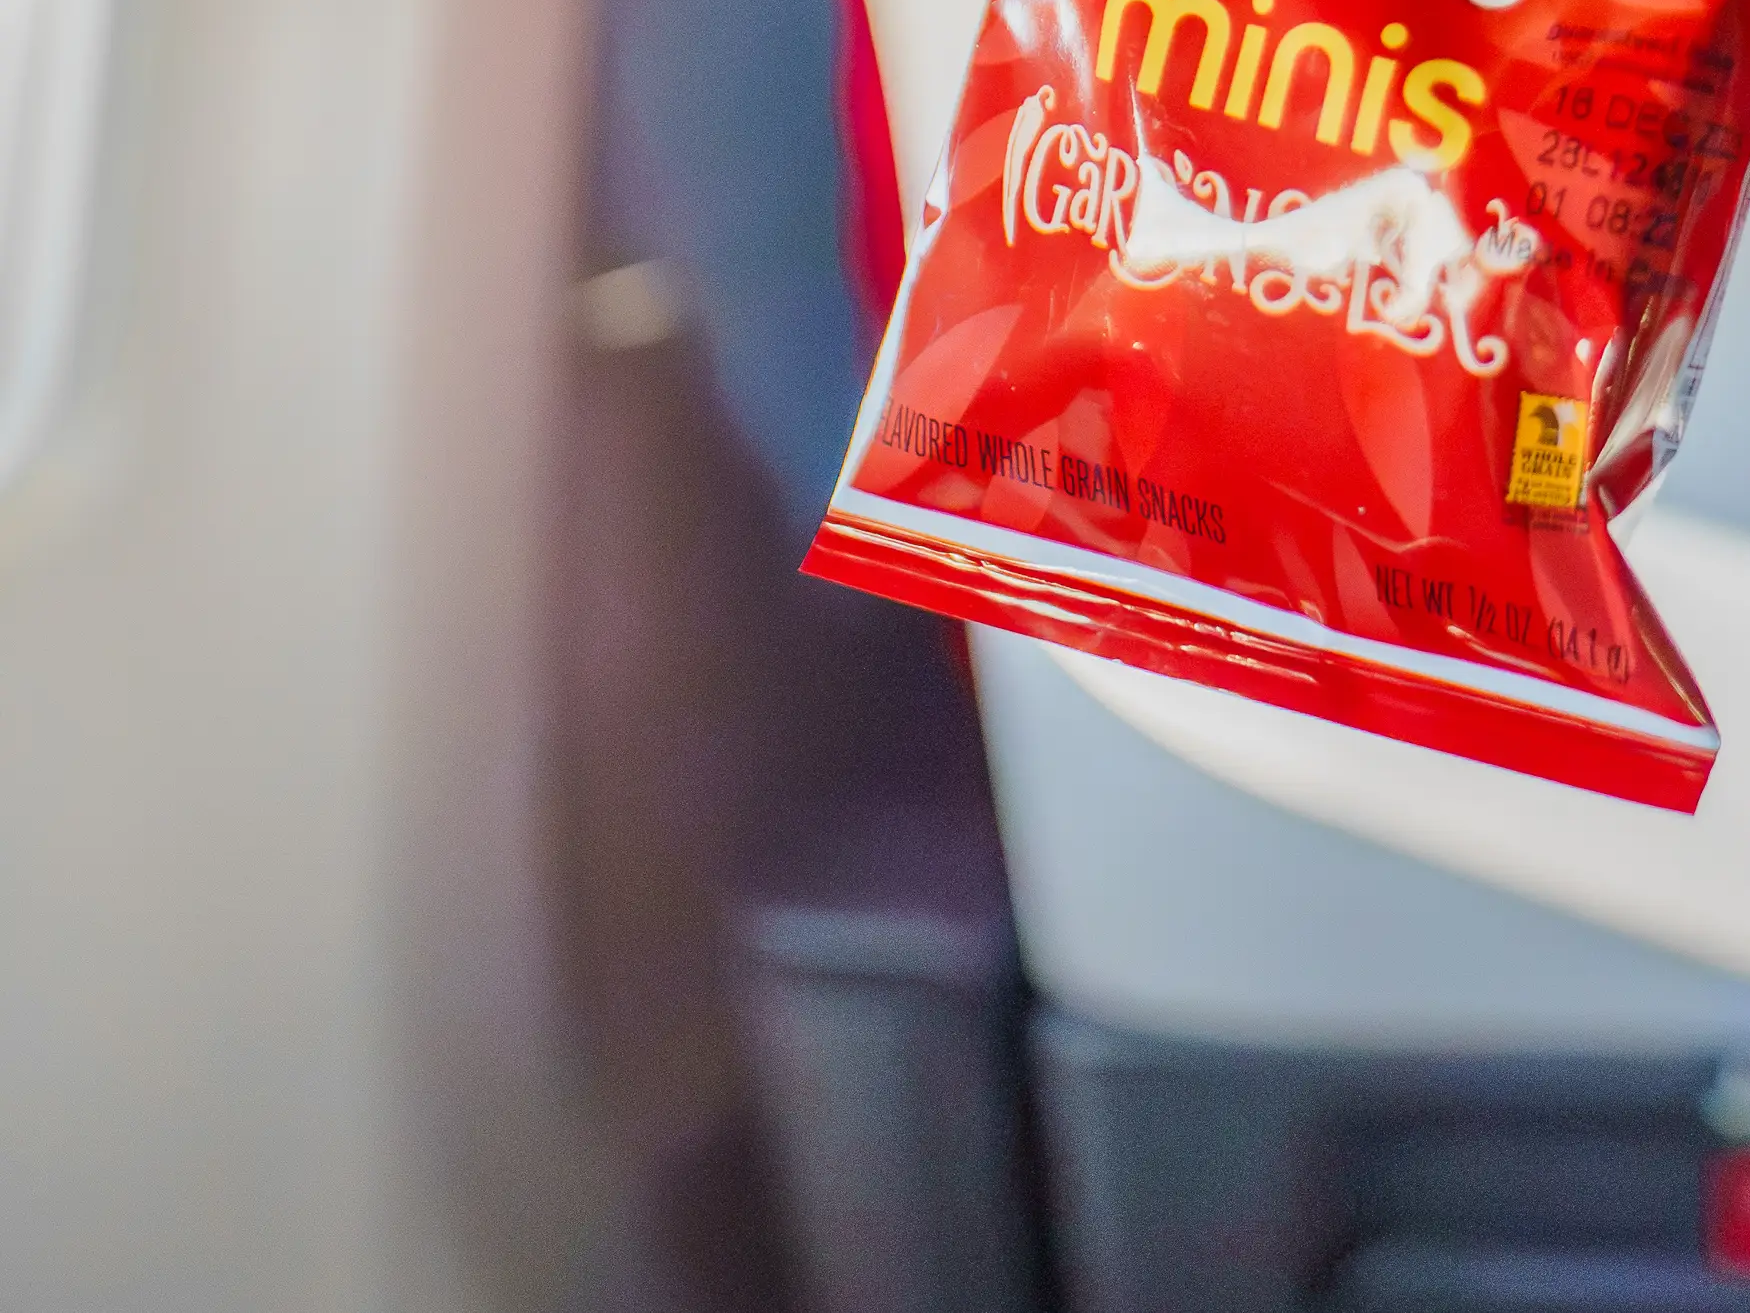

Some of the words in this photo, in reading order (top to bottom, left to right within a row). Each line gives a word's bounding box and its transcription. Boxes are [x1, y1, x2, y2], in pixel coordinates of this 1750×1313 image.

[976, 430, 1055, 491] WHOLE
[1061, 455, 1132, 514] GRAIN
[1137, 477, 1227, 545] SNACKS
[1375, 564, 1414, 610] NET
